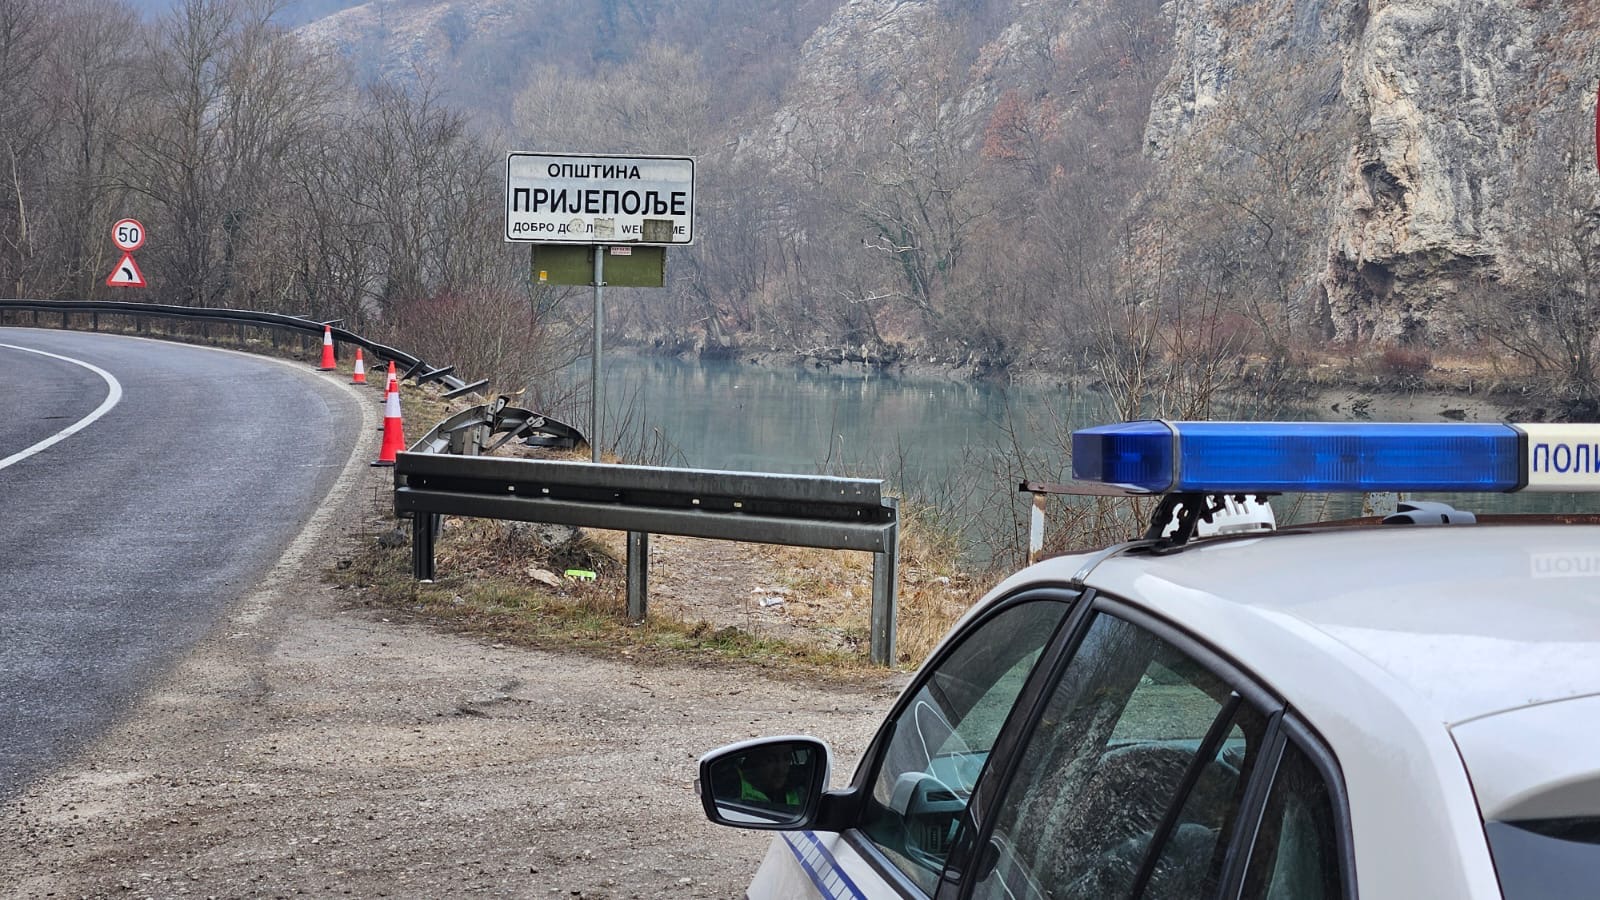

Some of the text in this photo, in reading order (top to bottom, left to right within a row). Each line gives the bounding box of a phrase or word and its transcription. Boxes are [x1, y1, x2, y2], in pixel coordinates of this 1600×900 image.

[547, 163, 641, 180] ОПШТИНА
[513, 187, 686, 216] ПРИЈЕПОЉЕ
[118, 226, 139, 243] 50
[513, 222, 555, 234] ДОБРО
